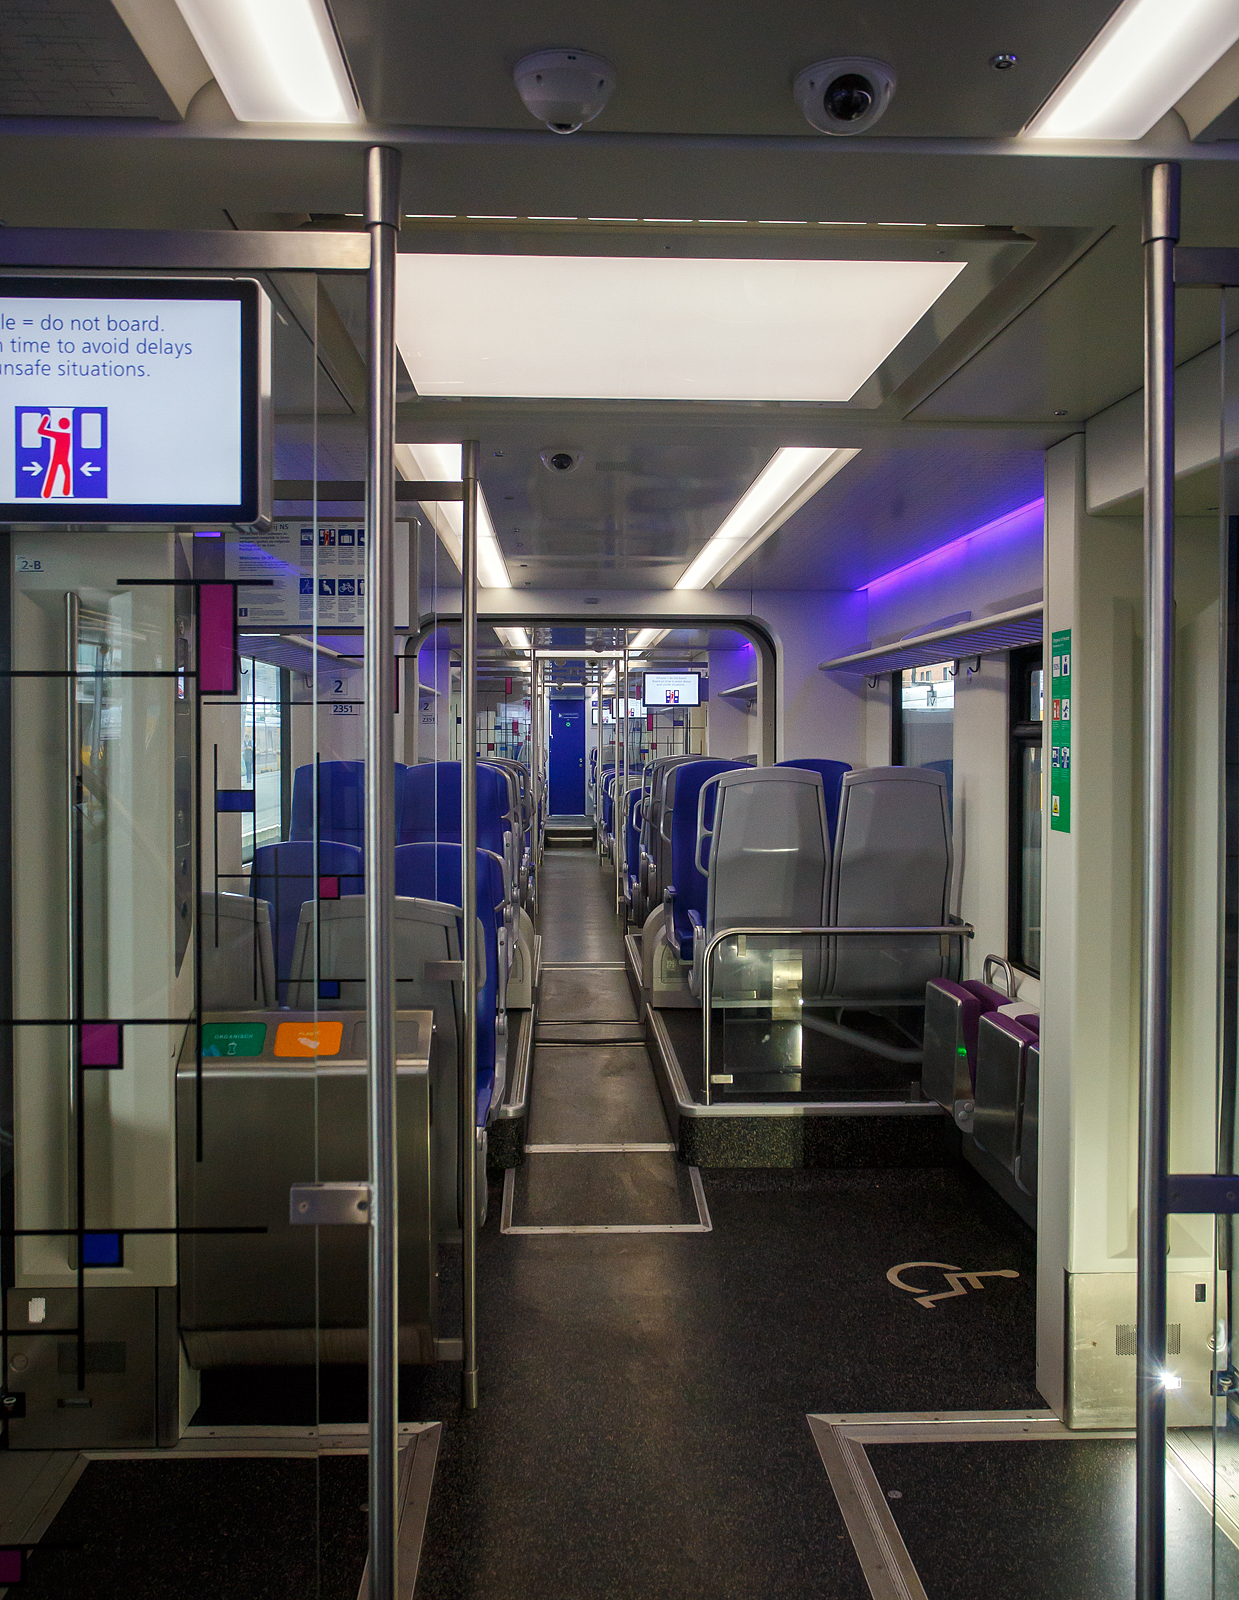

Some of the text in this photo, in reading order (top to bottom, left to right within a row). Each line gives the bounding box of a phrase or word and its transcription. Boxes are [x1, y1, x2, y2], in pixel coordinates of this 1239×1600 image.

[1, 313, 16, 330] le
[40, 313, 64, 331] do
[71, 316, 101, 331] not
[107, 314, 164, 332] board.
[9, 336, 51, 354] time
[57, 339, 75, 354] to
[82, 337, 129, 355] avoid
[136, 337, 193, 359] delays
[0, 359, 151, 377] nsafe situations.
[21, 560, 41, 570] 2-B
[334, 680, 343, 693] 2
[333, 705, 353, 713] 2351
[422, 702, 430, 711] 2
